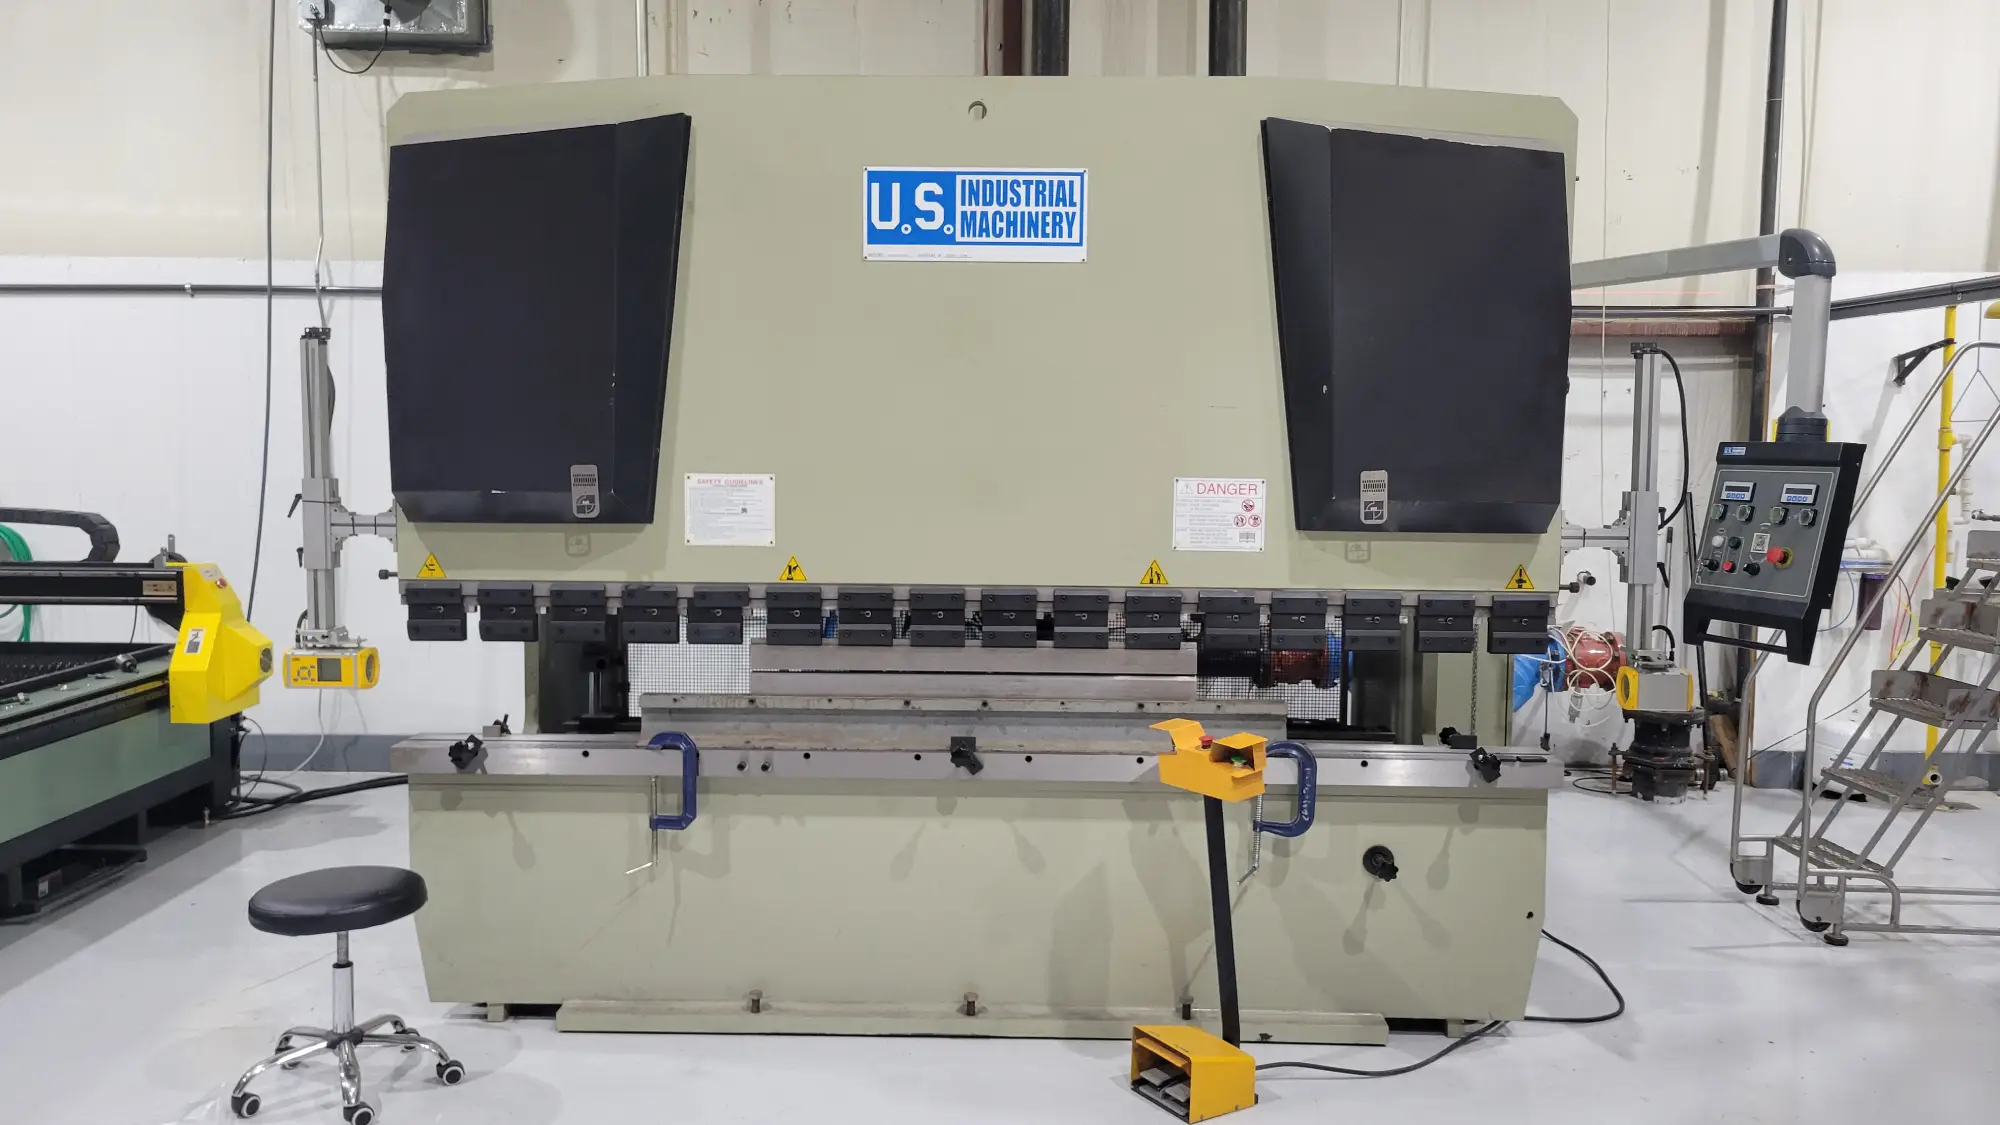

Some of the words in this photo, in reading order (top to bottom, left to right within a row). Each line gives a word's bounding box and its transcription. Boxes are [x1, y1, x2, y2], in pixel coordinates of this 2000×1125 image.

[960, 179, 1077, 207] INDUSTRIAL
[871, 182, 954, 235] U.S.
[960, 210, 1077, 239] MACHINERY
[1196, 482, 1258, 496] DANGER
